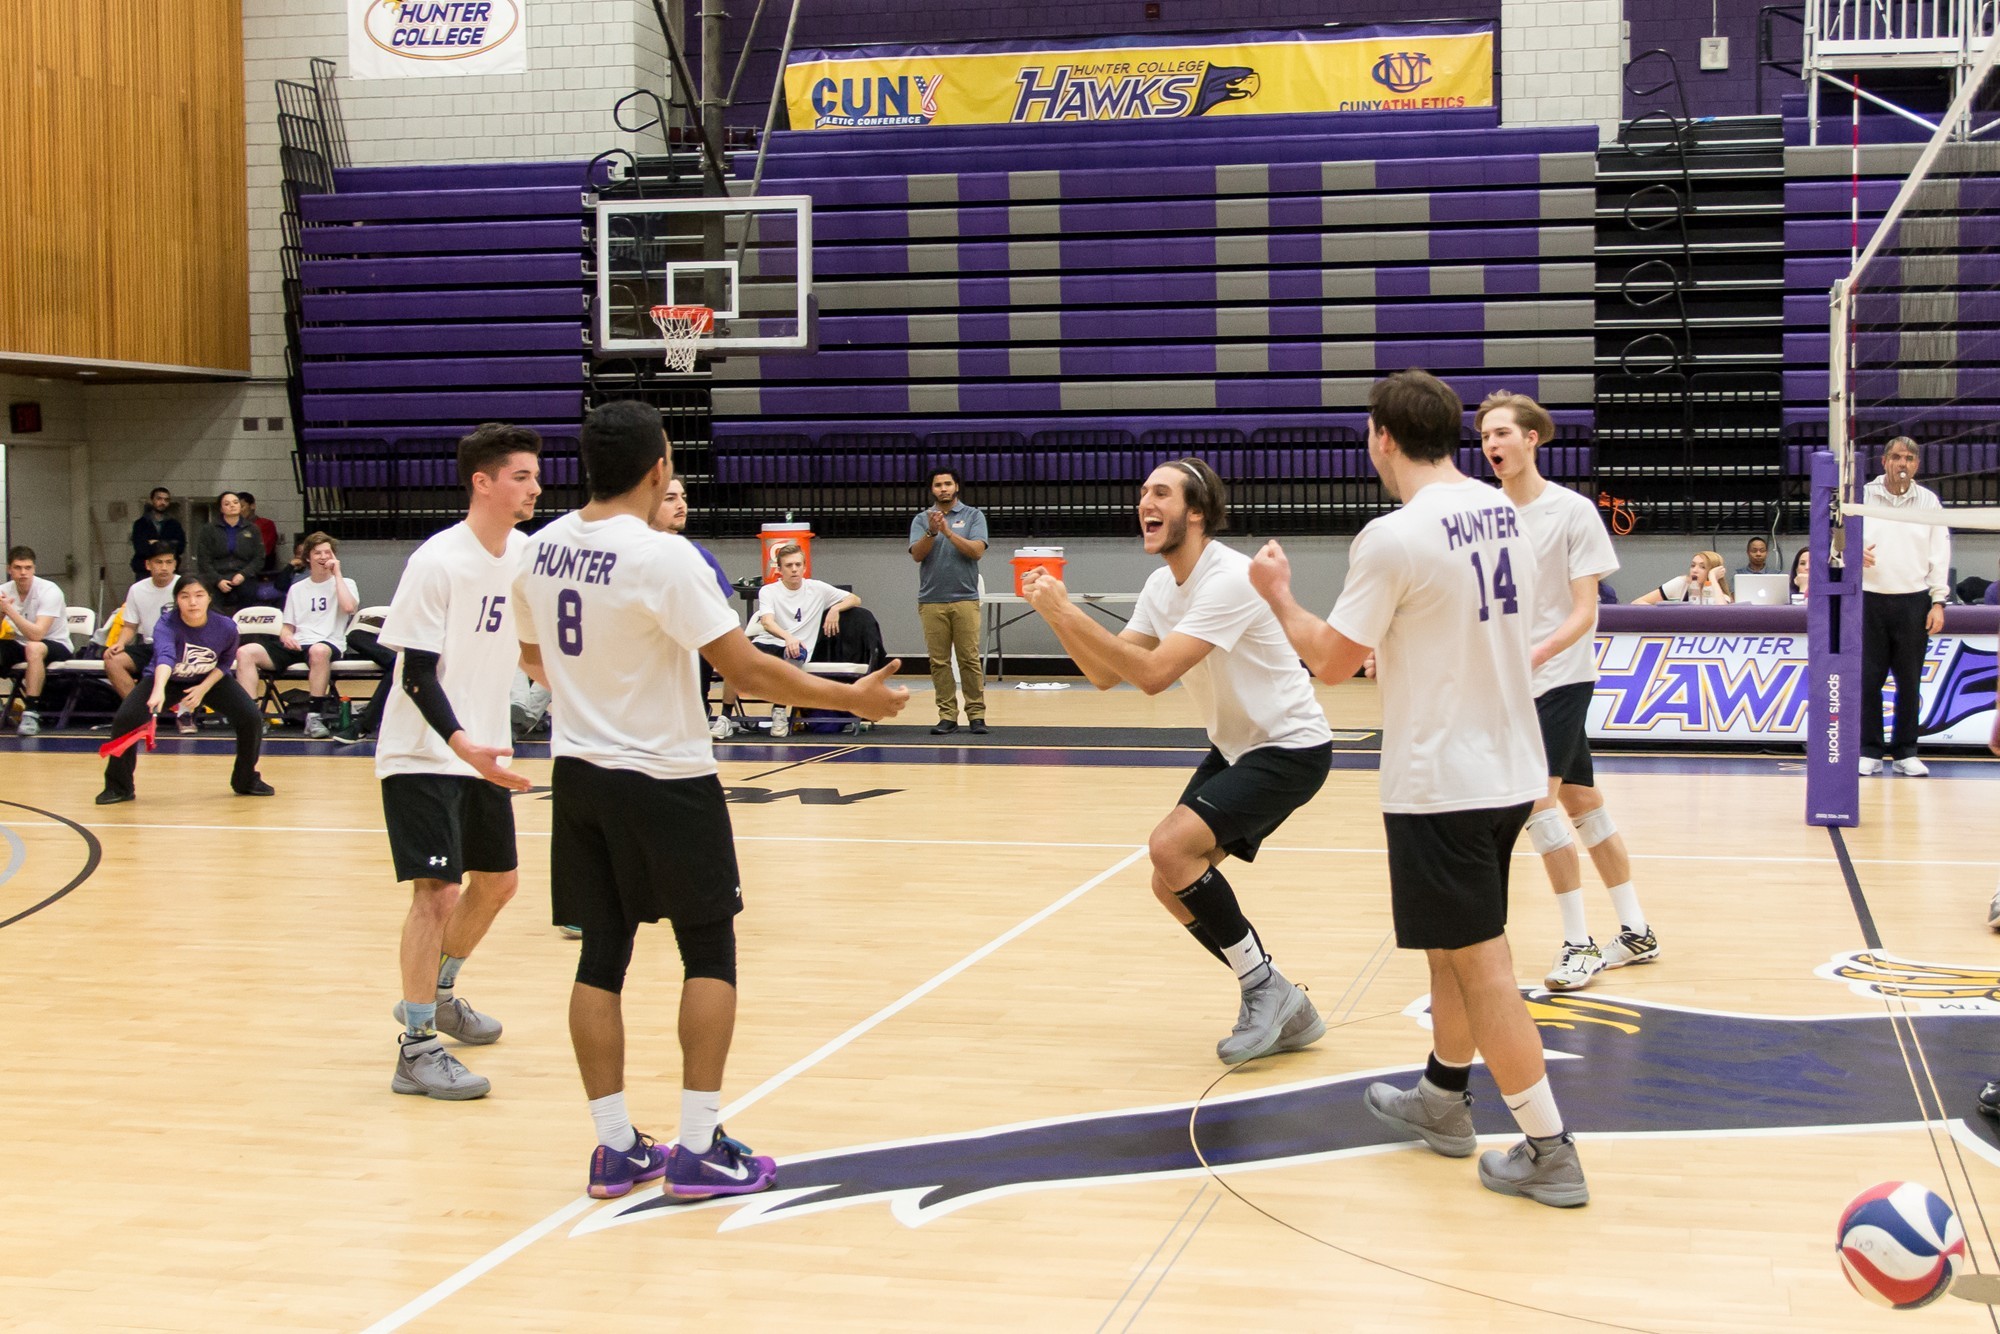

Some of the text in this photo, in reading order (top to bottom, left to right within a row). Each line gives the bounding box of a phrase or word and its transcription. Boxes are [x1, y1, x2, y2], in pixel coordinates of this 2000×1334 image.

[398, 2, 492, 23] HUNTER
[391, 27, 486, 46] COLLEGE
[1073, 60, 1206, 75] HUNTER COLLEGE
[811, 74, 944, 118] CUNY
[1010, 64, 1201, 123] HAWKS
[857, 115, 921, 126] CONFERENCE
[1440, 506, 1519, 551] HUNTER
[532, 542, 617, 585] HUNTER
[1470, 547, 1519, 622] 14
[311, 597, 327, 612] 13
[475, 595, 507, 633] 15
[794, 607, 802, 622] 4
[238, 615, 276, 624] HUNTER
[557, 588, 583, 657] 8
[1676, 636, 1794, 655] HUNTER
[1827, 674, 1840, 713] sports
